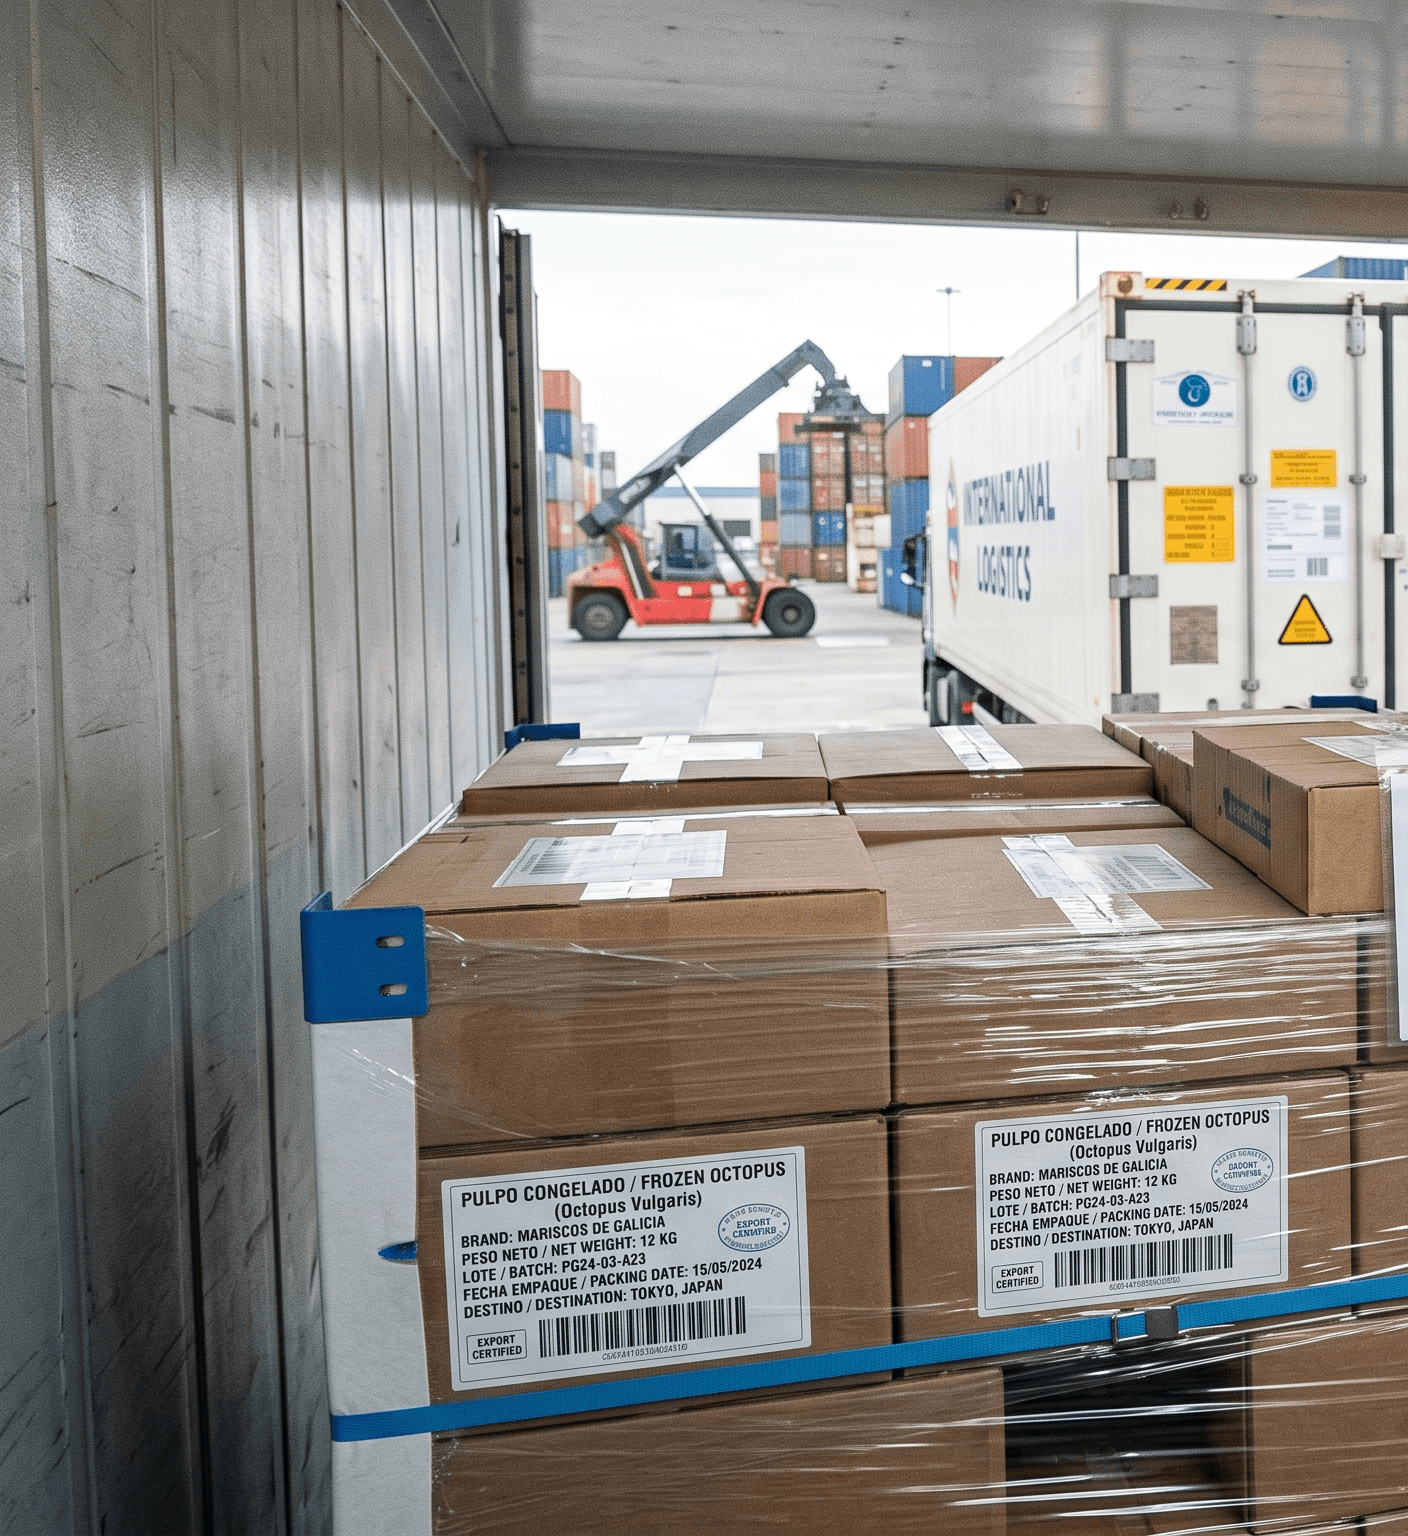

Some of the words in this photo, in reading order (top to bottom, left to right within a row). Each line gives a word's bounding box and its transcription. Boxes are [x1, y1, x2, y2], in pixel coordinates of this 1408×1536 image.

[963, 460, 1055, 526] INTERNATIONAL
[977, 545, 1032, 602] LOGISTICS
[992, 1130, 1040, 1148] PULPO
[1045, 1122, 1131, 1143] CONGELADO
[1136, 1120, 1142, 1136] /
[1147, 1116, 1200, 1133] FROZEN
[1205, 1109, 1269, 1128] OCTOPUS
[1070, 1144, 1131, 1162] (Octopus
[1136, 1135, 1197, 1155] Vulgaris)
[462, 1188, 517, 1207] PULPO
[524, 1177, 625, 1201] CONGELADO
[630, 1176, 636, 1192] /
[641, 1169, 704, 1190] FROZEN
[711, 1161, 785, 1183] OCTOPUS
[990, 1171, 1034, 1185] BRAND:
[1039, 1164, 1100, 1181] MARISCOS
[1104, 1162, 1118, 1174] DE
[1122, 1158, 1167, 1173] GALICIA
[990, 1188, 1020, 1202] PESO
[1025, 1184, 1055, 1198] NETO
[1059, 1184, 1064, 1196] /
[1067, 1181, 1089, 1194] NET
[1092, 1177, 1140, 1192] WEIGHT:
[1145, 1175, 1158, 1187] 12
[1162, 1174, 1177, 1186] KG
[555, 1201, 626, 1222] (Octopus
[631, 1190, 702, 1212] Vulgaris)
[990, 1204, 1019, 1218] LOTE
[1022, 1203, 1028, 1215] /
[1031, 1200, 1072, 1214] BATCH:
[1076, 1192, 1150, 1209] PG24-03-A23
[990, 1220, 1028, 1234] FECHA
[1033, 1213, 1089, 1230] EMPAQUE
[1092, 1213, 1097, 1225] /
[1101, 1208, 1150, 1223] PACKING
[1154, 1205, 1185, 1218] DATE:
[461, 1232, 512, 1248] BRAND:
[518, 1223, 588, 1242] MARISCOS
[593, 1221, 609, 1234] DE
[614, 1216, 665, 1232] GALICIA
[991, 1234, 1041, 1251] DESTINO
[1044, 1234, 1049, 1246] /
[1052, 1226, 1131, 1244] DESTINATION:
[1134, 1222, 1175, 1236] TOKYO,
[1178, 1217, 1213, 1231] JAPAN
[462, 1250, 497, 1266] PESO
[502, 1246, 538, 1261] NETO
[542, 1245, 547, 1258] /
[551, 1242, 577, 1256] NET
[580, 1236, 636, 1253] WEIGHT:
[640, 1234, 655, 1247] 12
[660, 1232, 677, 1245] KG
[463, 1268, 496, 1284] LOTE
[500, 1267, 506, 1280] /
[509, 1262, 557, 1279] BATCH:
[562, 1252, 646, 1273] PG24-03-A23
[463, 1285, 508, 1301] FECHA
[512, 1277, 577, 1296] EMPAQUE
[581, 1276, 586, 1289] /
[590, 1270, 647, 1287] PACKING
[651, 1266, 688, 1281] DATE:
[693, 1257, 762, 1276] 15/05/2024
[996, 1276, 1039, 1289] CERTIFIED
[1001, 1266, 1034, 1278] EXPORT
[464, 1300, 523, 1319] DESTINO
[526, 1299, 532, 1313] /
[536, 1290, 627, 1311] DESTINATION:
[630, 1284, 678, 1300] TOKYO,
[682, 1278, 722, 1295] JAPAN
[472, 1345, 522, 1360] CERTIFIED
[477, 1335, 515, 1347] EXPORT
